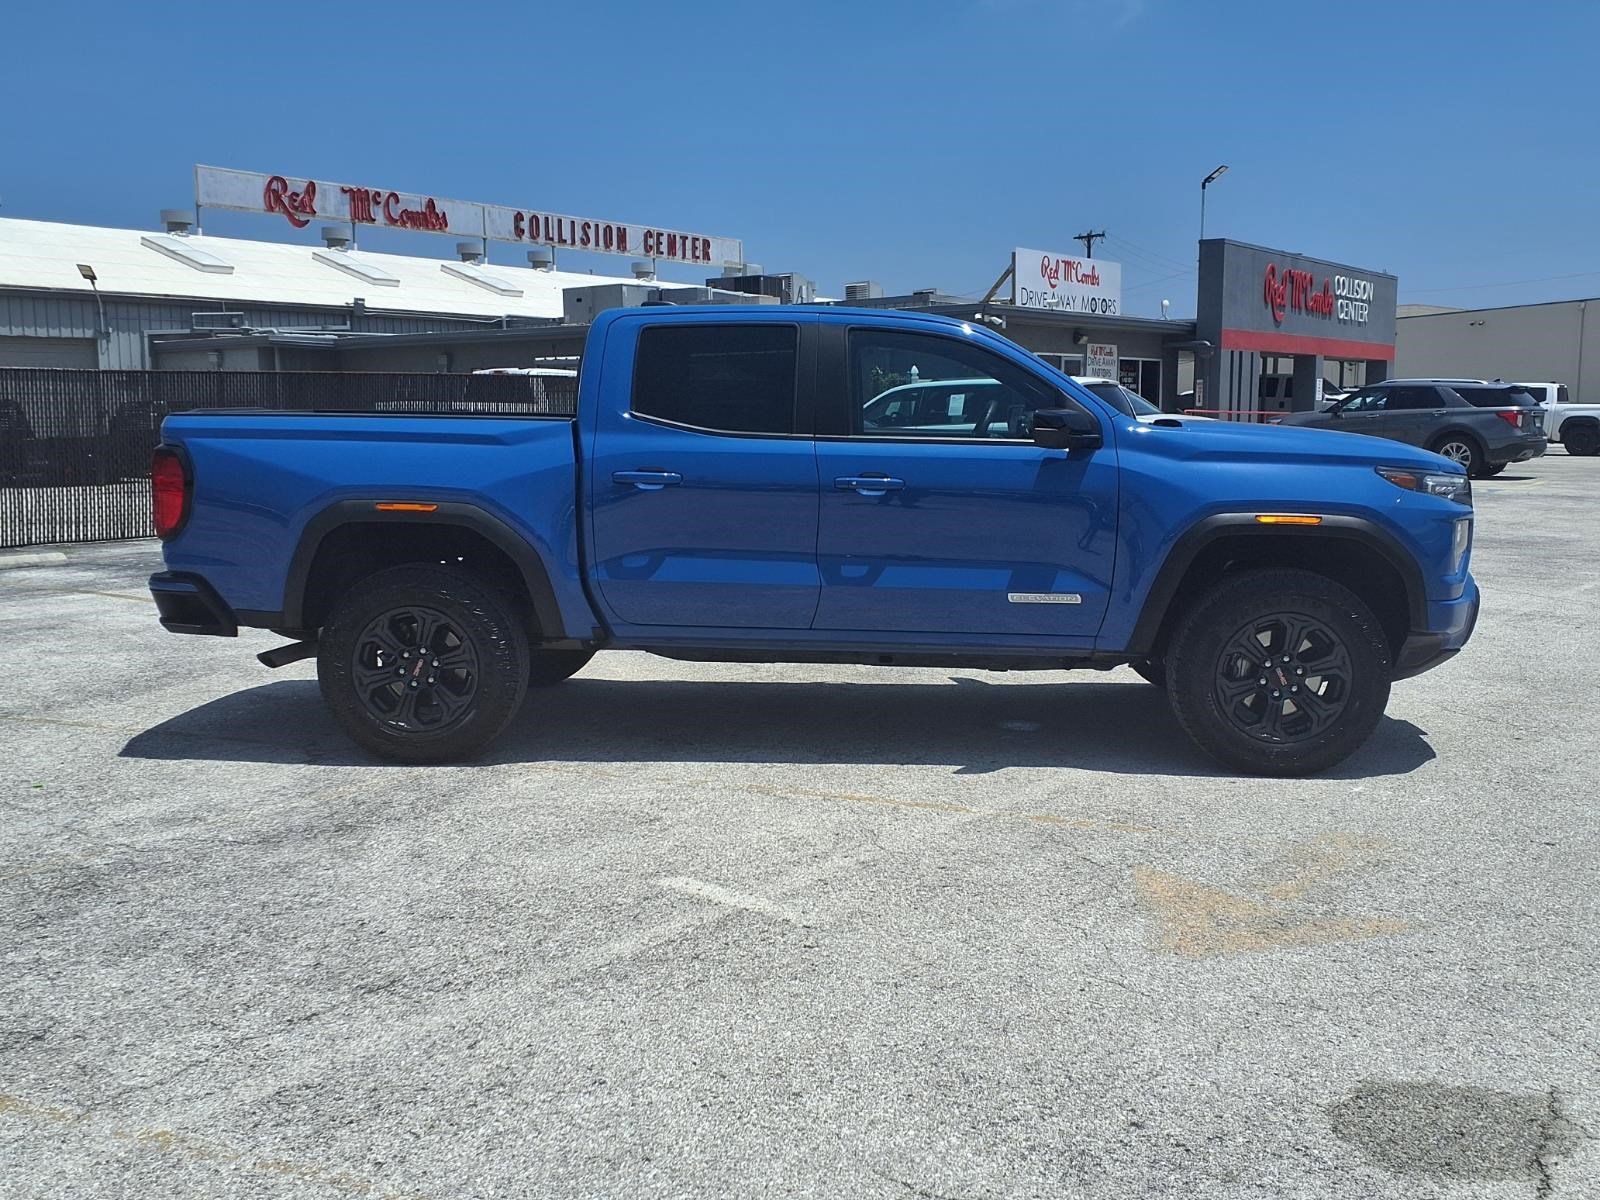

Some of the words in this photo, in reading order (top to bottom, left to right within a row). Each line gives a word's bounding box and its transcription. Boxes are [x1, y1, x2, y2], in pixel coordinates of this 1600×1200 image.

[263, 175, 317, 229] Red
[341, 186, 449, 232] McCombs
[513, 210, 627, 252] COLLISION
[643, 229, 711, 262] CENTER
[1041, 255, 1060, 289] Red
[1061, 259, 1100, 287] McCombs
[1020, 287, 1048, 308] DRIVE
[1081, 295, 1117, 315] MOTORS
[1264, 262, 1289, 323] Red
[1334, 275, 1374, 302] COLLISION
[1337, 299, 1369, 323] CENTER
[1012, 594, 1077, 602] ELEVATION
